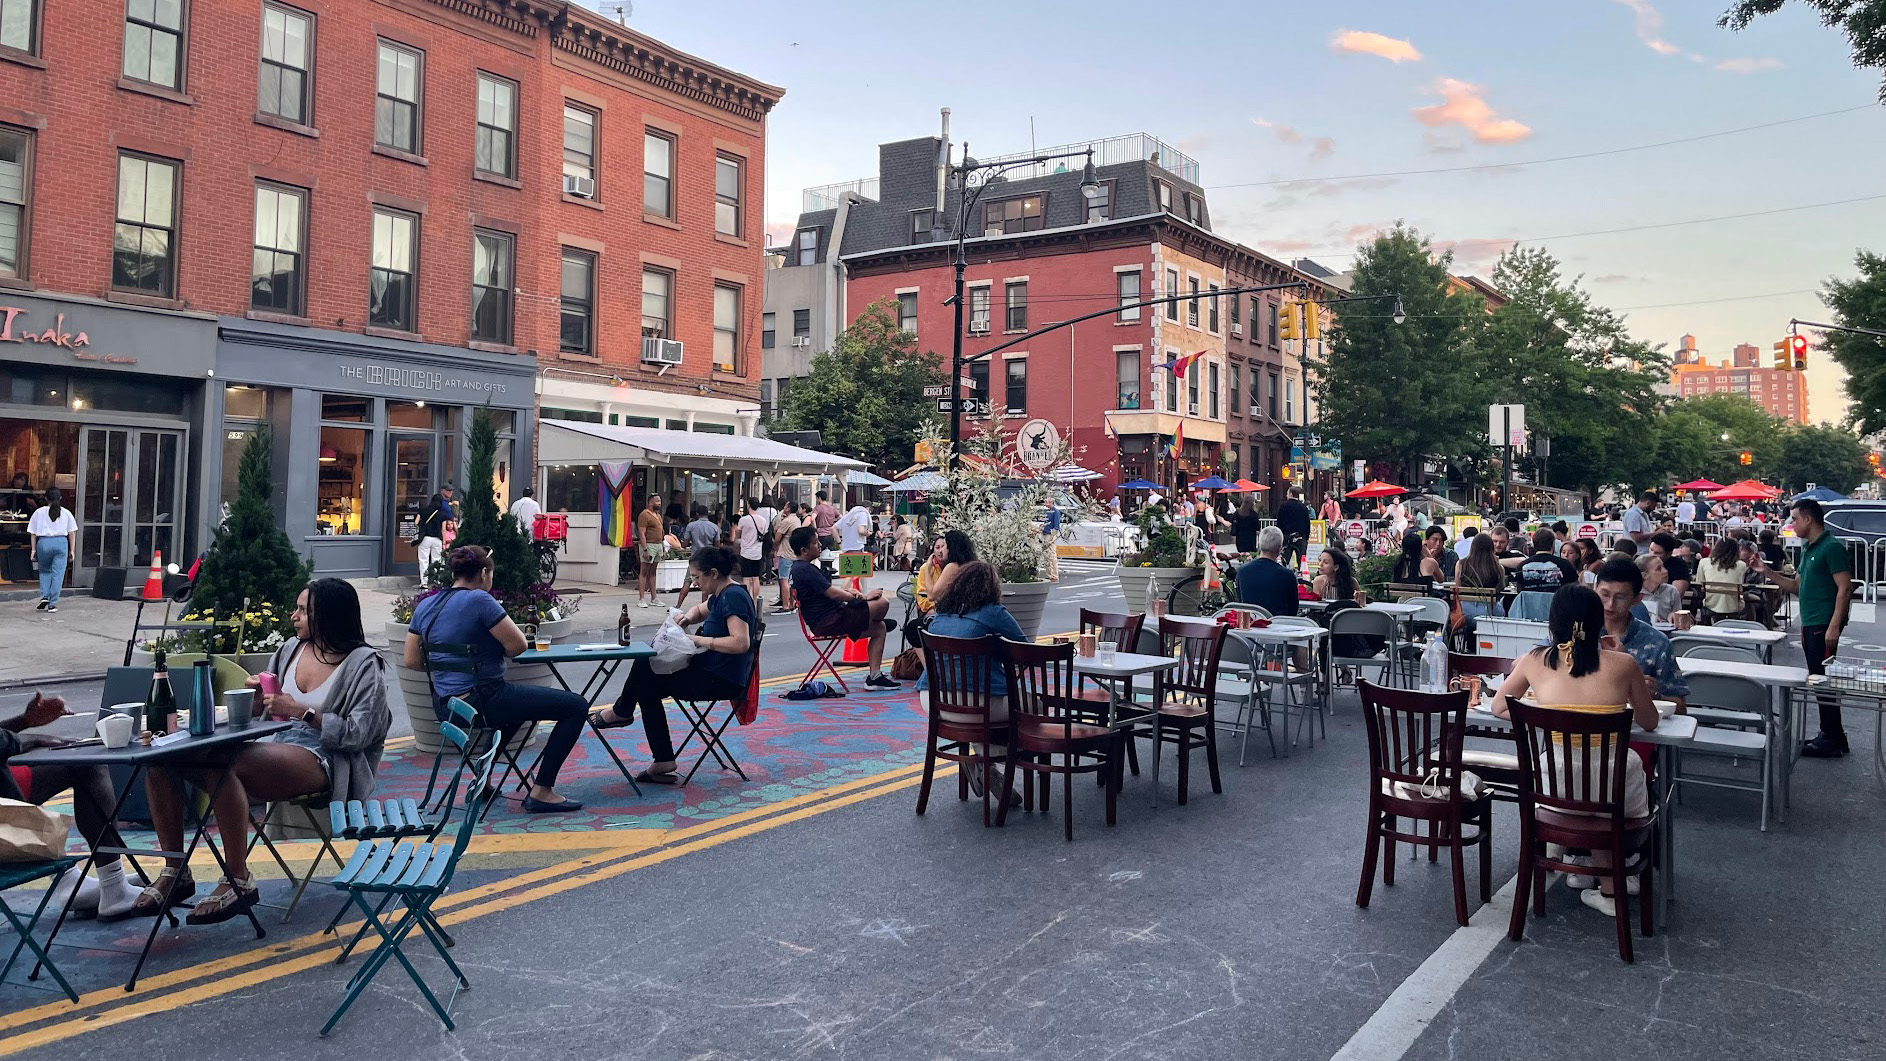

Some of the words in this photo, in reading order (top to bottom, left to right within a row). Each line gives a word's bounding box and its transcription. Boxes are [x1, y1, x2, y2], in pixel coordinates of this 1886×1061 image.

[0, 307, 90, 349] Inaka
[340, 365, 363, 379] THE
[366, 365, 442, 391] BRICK
[444, 379, 461, 389] ART
[463, 381, 481, 391] AND
[483, 383, 506, 393] GIFTS
[923, 387, 943, 397] BERGEN
[943, 386, 951, 396] ST
[229, 432, 244, 440] 599
